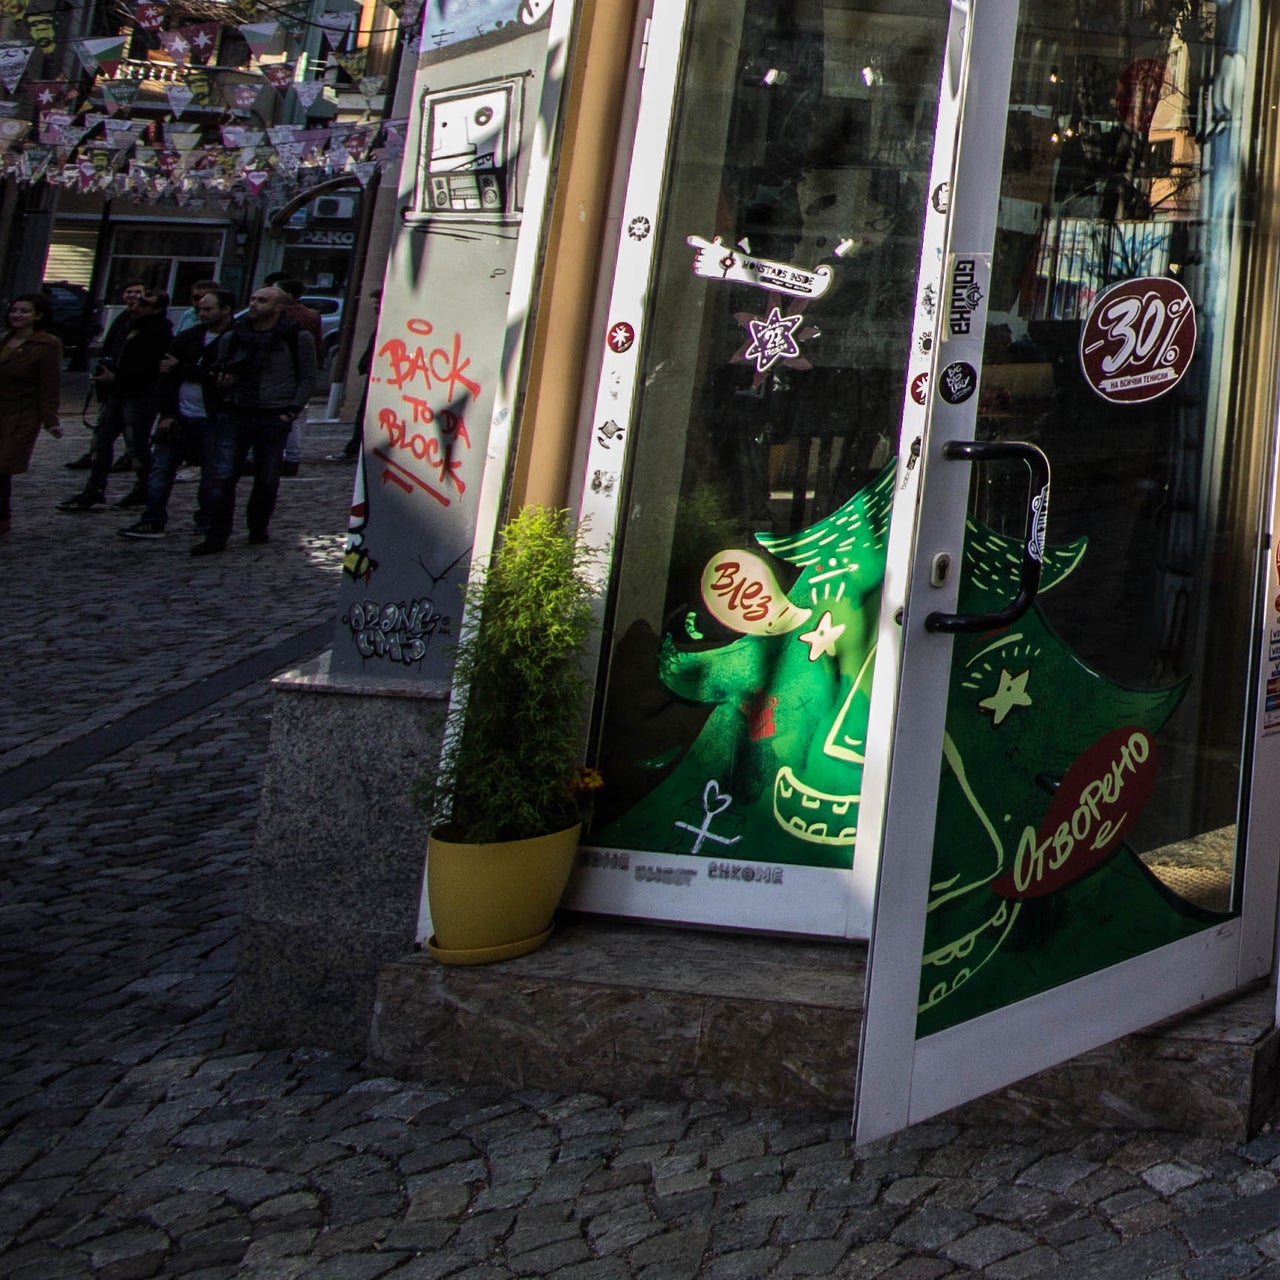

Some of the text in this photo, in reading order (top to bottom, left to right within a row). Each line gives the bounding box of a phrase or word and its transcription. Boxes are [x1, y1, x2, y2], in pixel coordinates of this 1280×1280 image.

[380, 332, 482, 402] BACK
[1085, 292, 1192, 376] -30%
[1111, 380, 1119, 390] НА
[379, 408, 466, 496] BLOCK
[402, 394, 471, 449] TO DA
